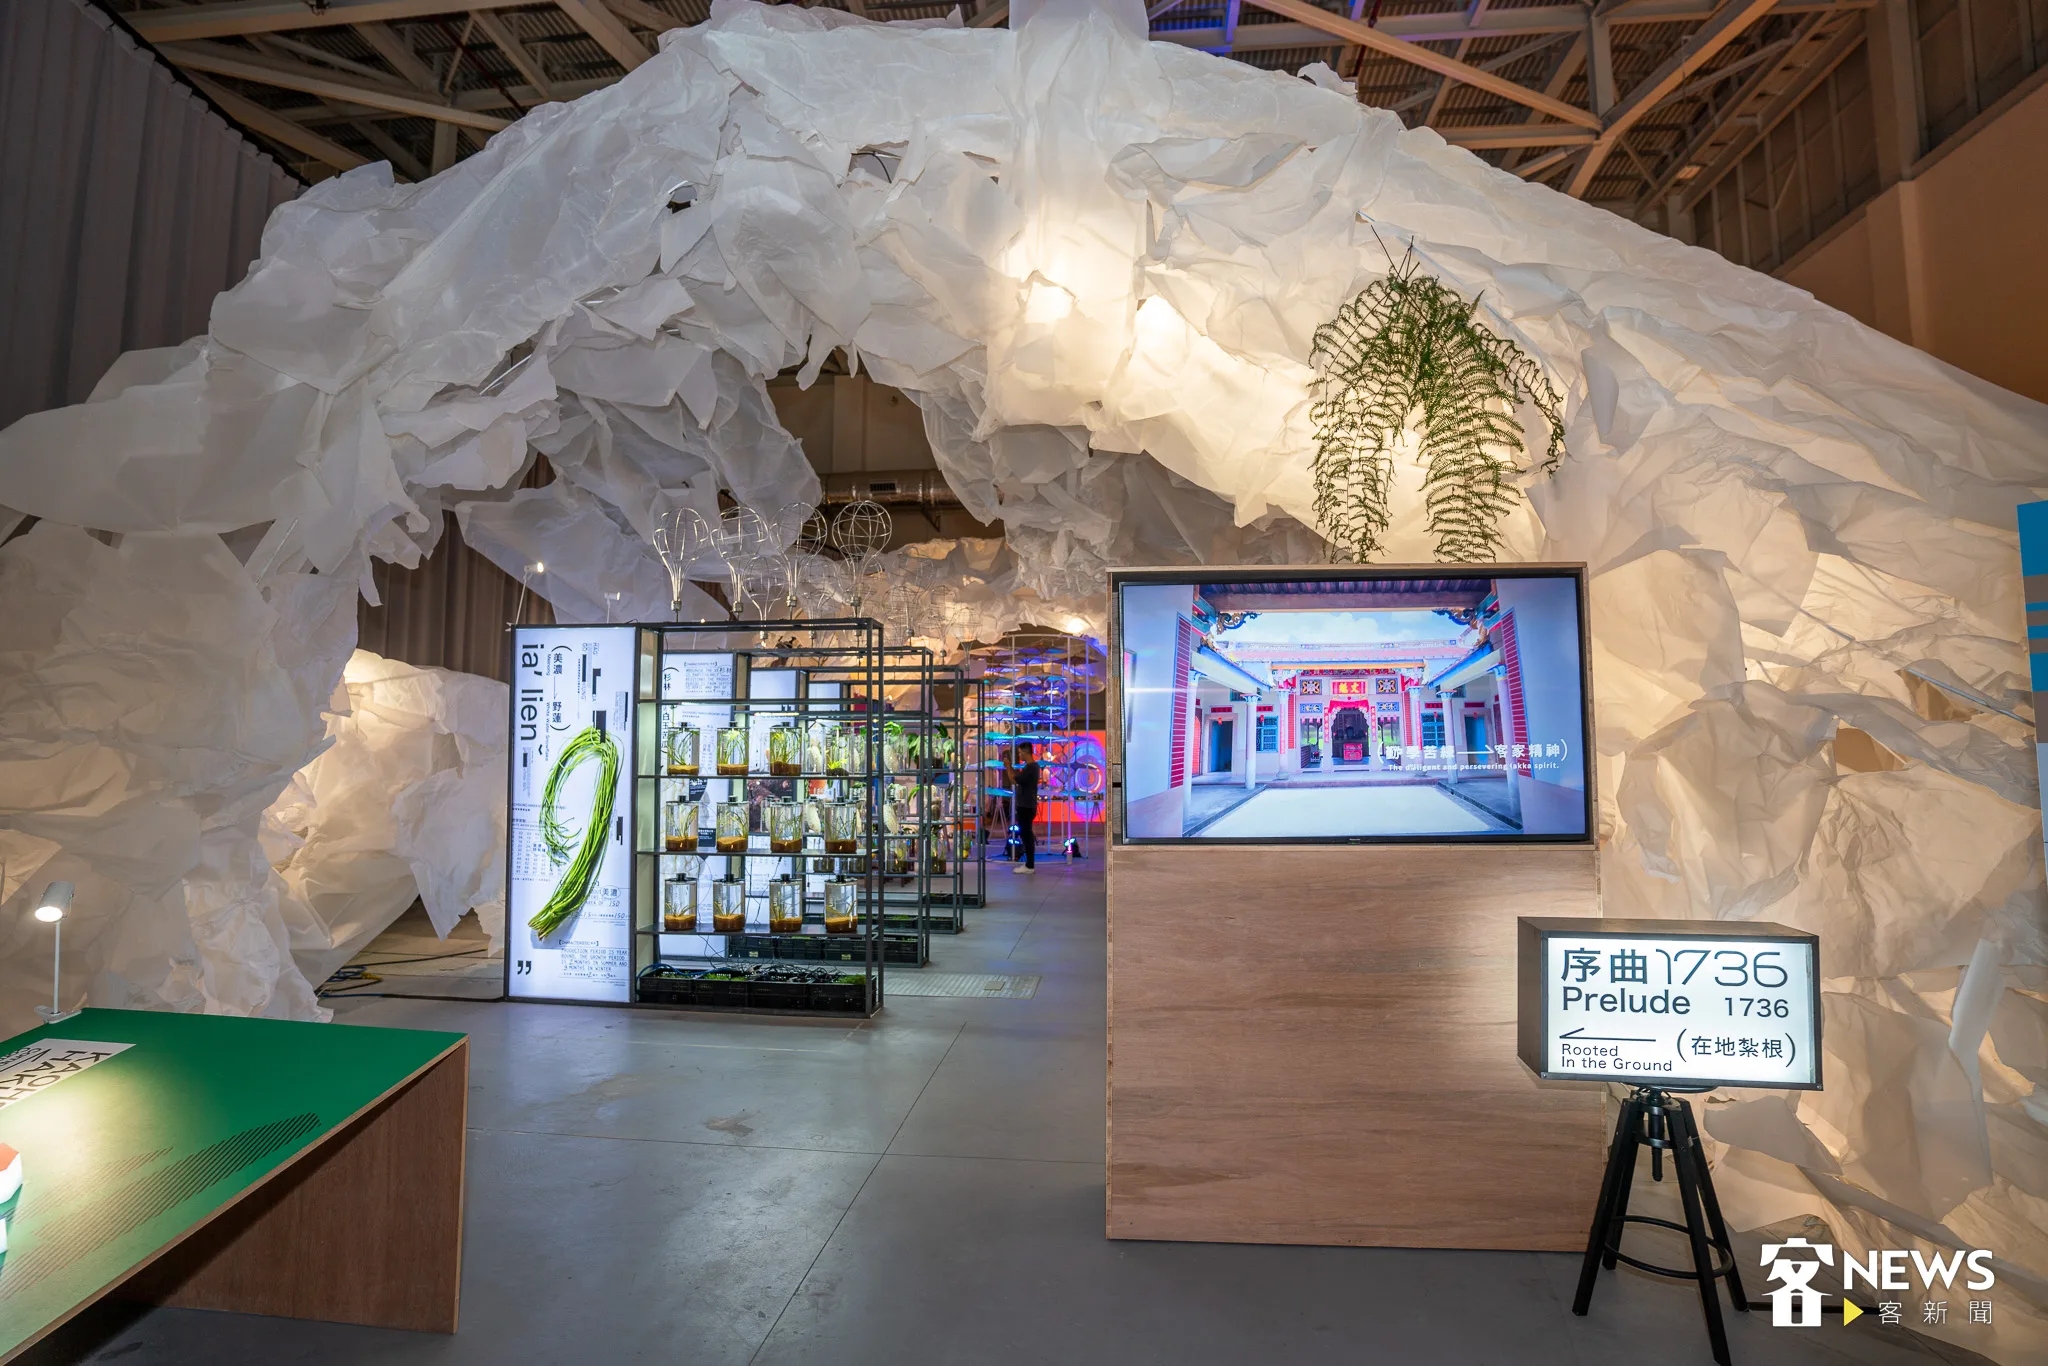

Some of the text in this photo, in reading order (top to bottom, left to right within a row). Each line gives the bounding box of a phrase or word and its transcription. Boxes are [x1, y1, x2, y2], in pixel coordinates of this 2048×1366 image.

[1460, 763, 1508, 771] persevering
[1534, 762, 1560, 770] spirit.
[1561, 985, 1790, 1018] Prelude 1736
[1561, 1043, 1619, 1058] Rooted
[1561, 1056, 1673, 1073] In the Ground
